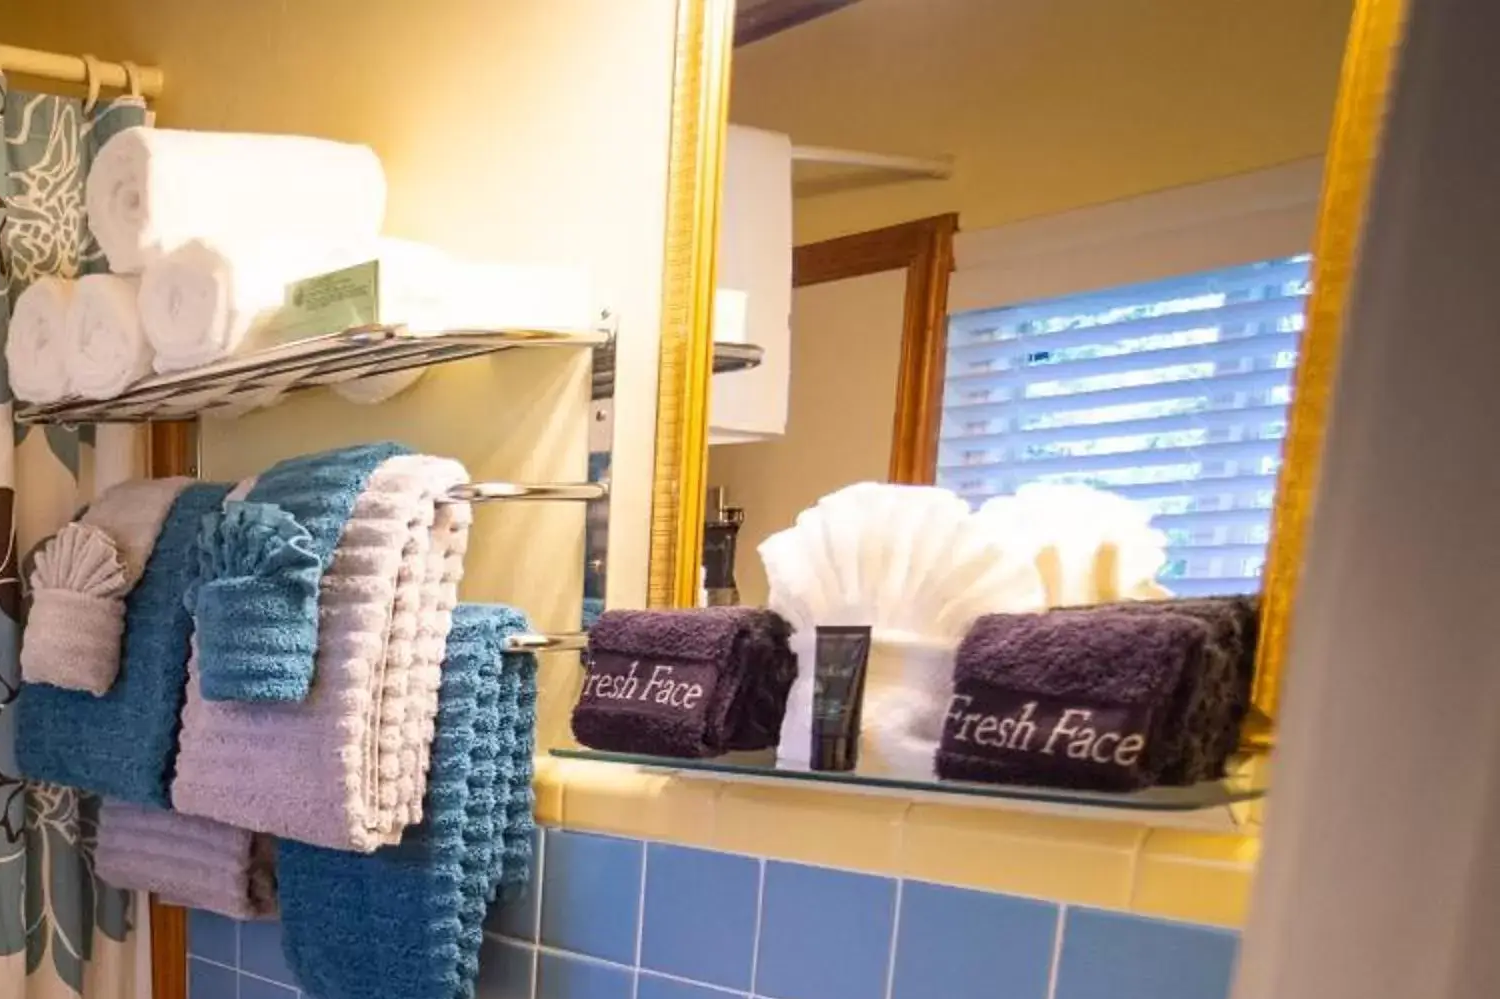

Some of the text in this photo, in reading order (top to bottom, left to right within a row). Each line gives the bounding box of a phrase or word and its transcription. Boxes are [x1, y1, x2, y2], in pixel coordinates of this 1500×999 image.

[583, 660, 704, 709] resh Face
[1040, 707, 1145, 766] Face
